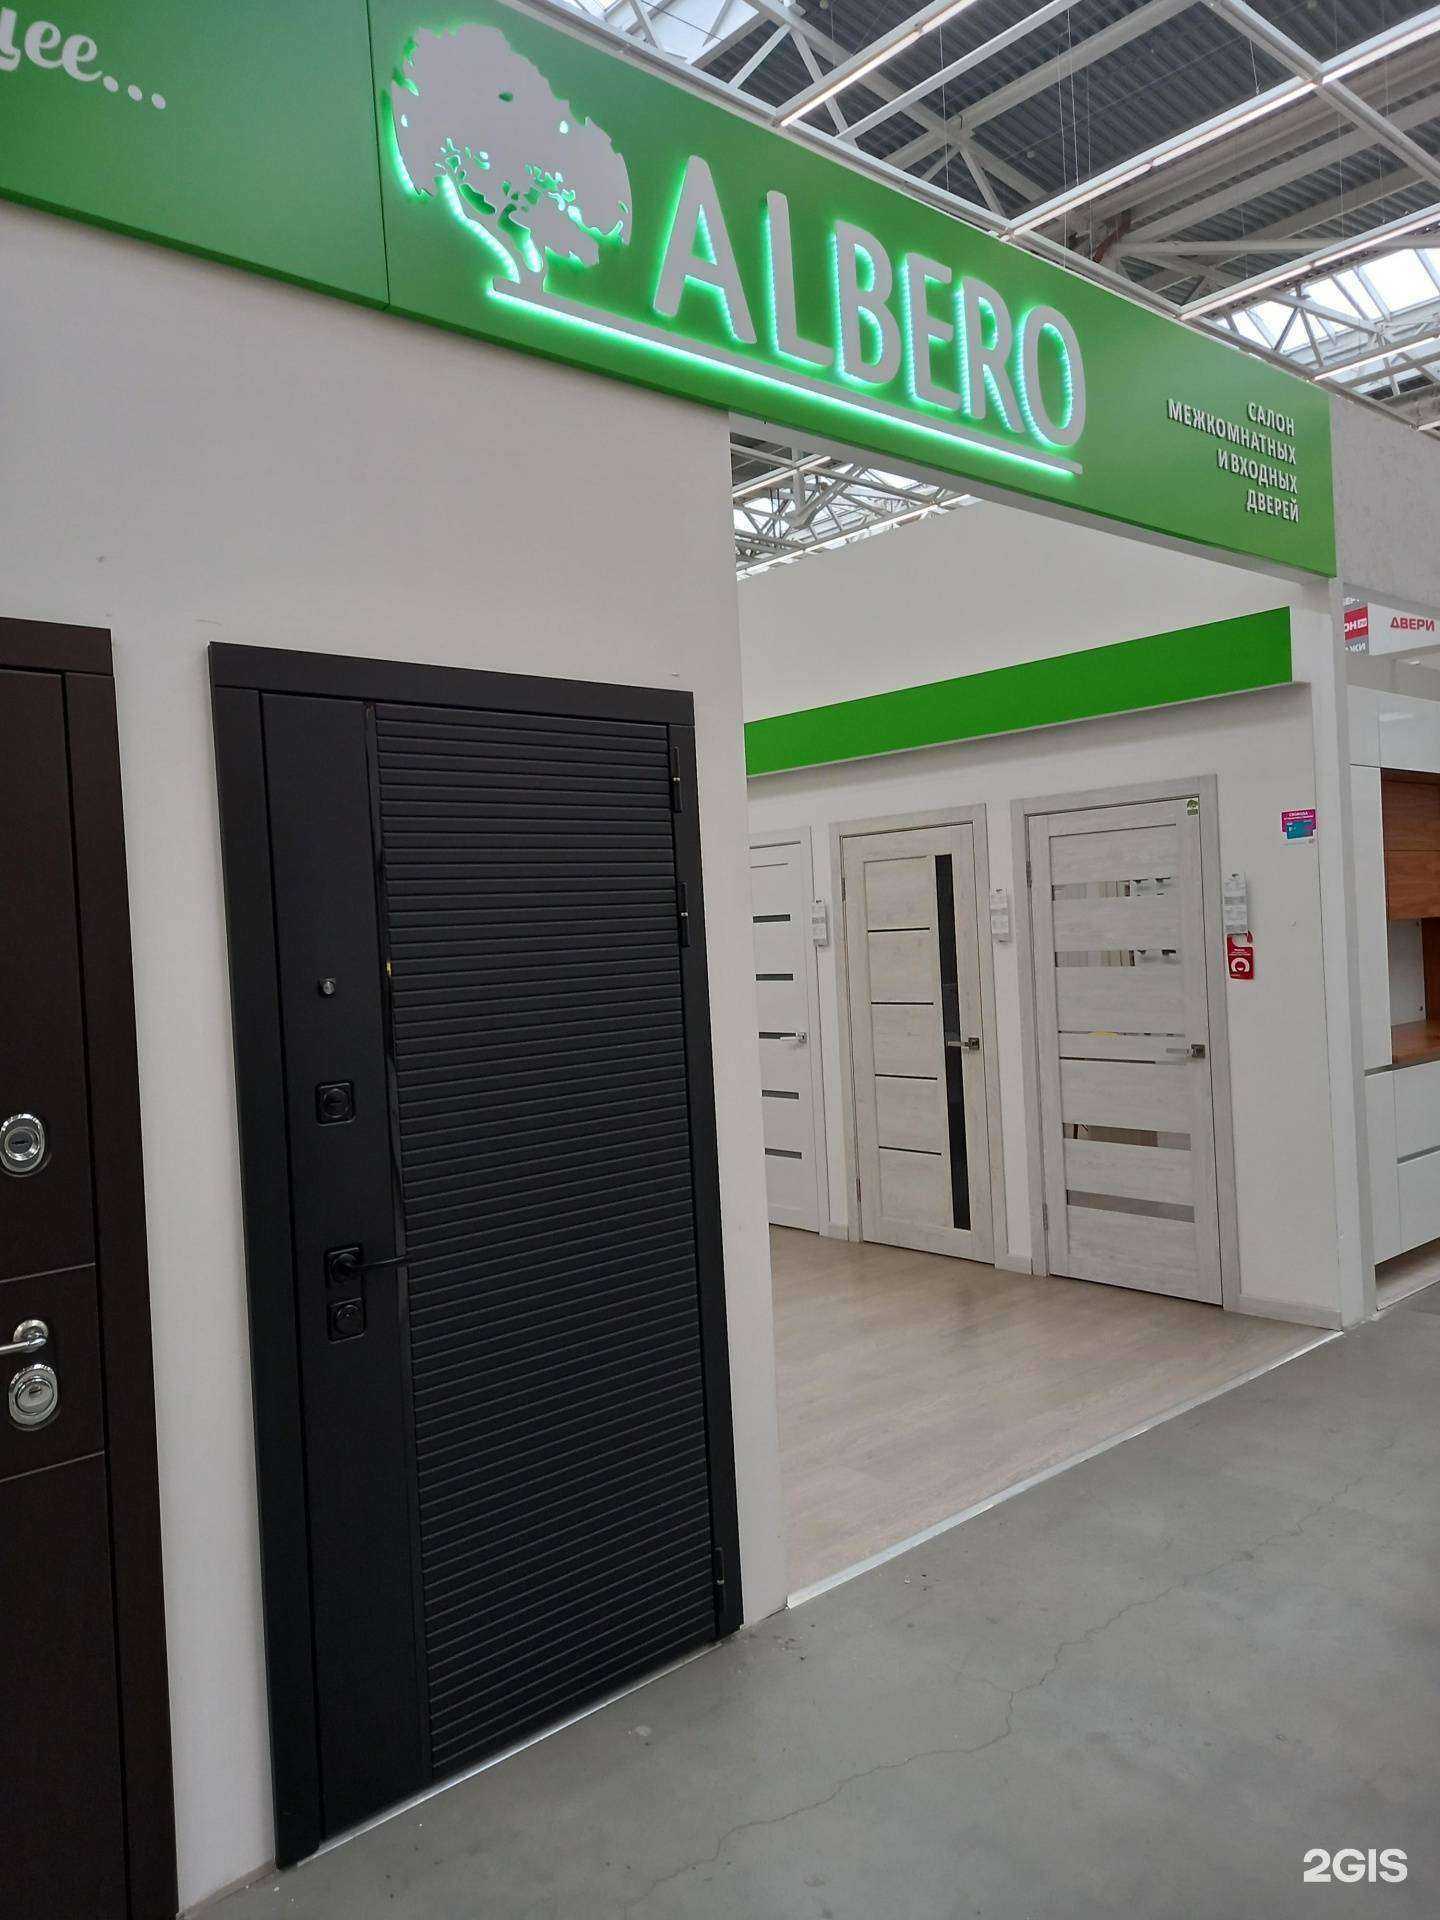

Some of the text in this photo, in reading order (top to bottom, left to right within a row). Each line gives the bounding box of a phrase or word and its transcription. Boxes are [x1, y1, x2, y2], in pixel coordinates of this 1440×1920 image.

[652, 155, 1087, 447] ALBERO
[1167, 398, 1297, 465] МЕЖКОМНАТНЫХ
[1247, 402, 1296, 437] САЛОН
[1216, 448, 1298, 494] И ВХОДНЫХ
[1246, 489, 1300, 523] ДВЕРЕЙ
[1390, 616, 1436, 632] ДВЕРИ
